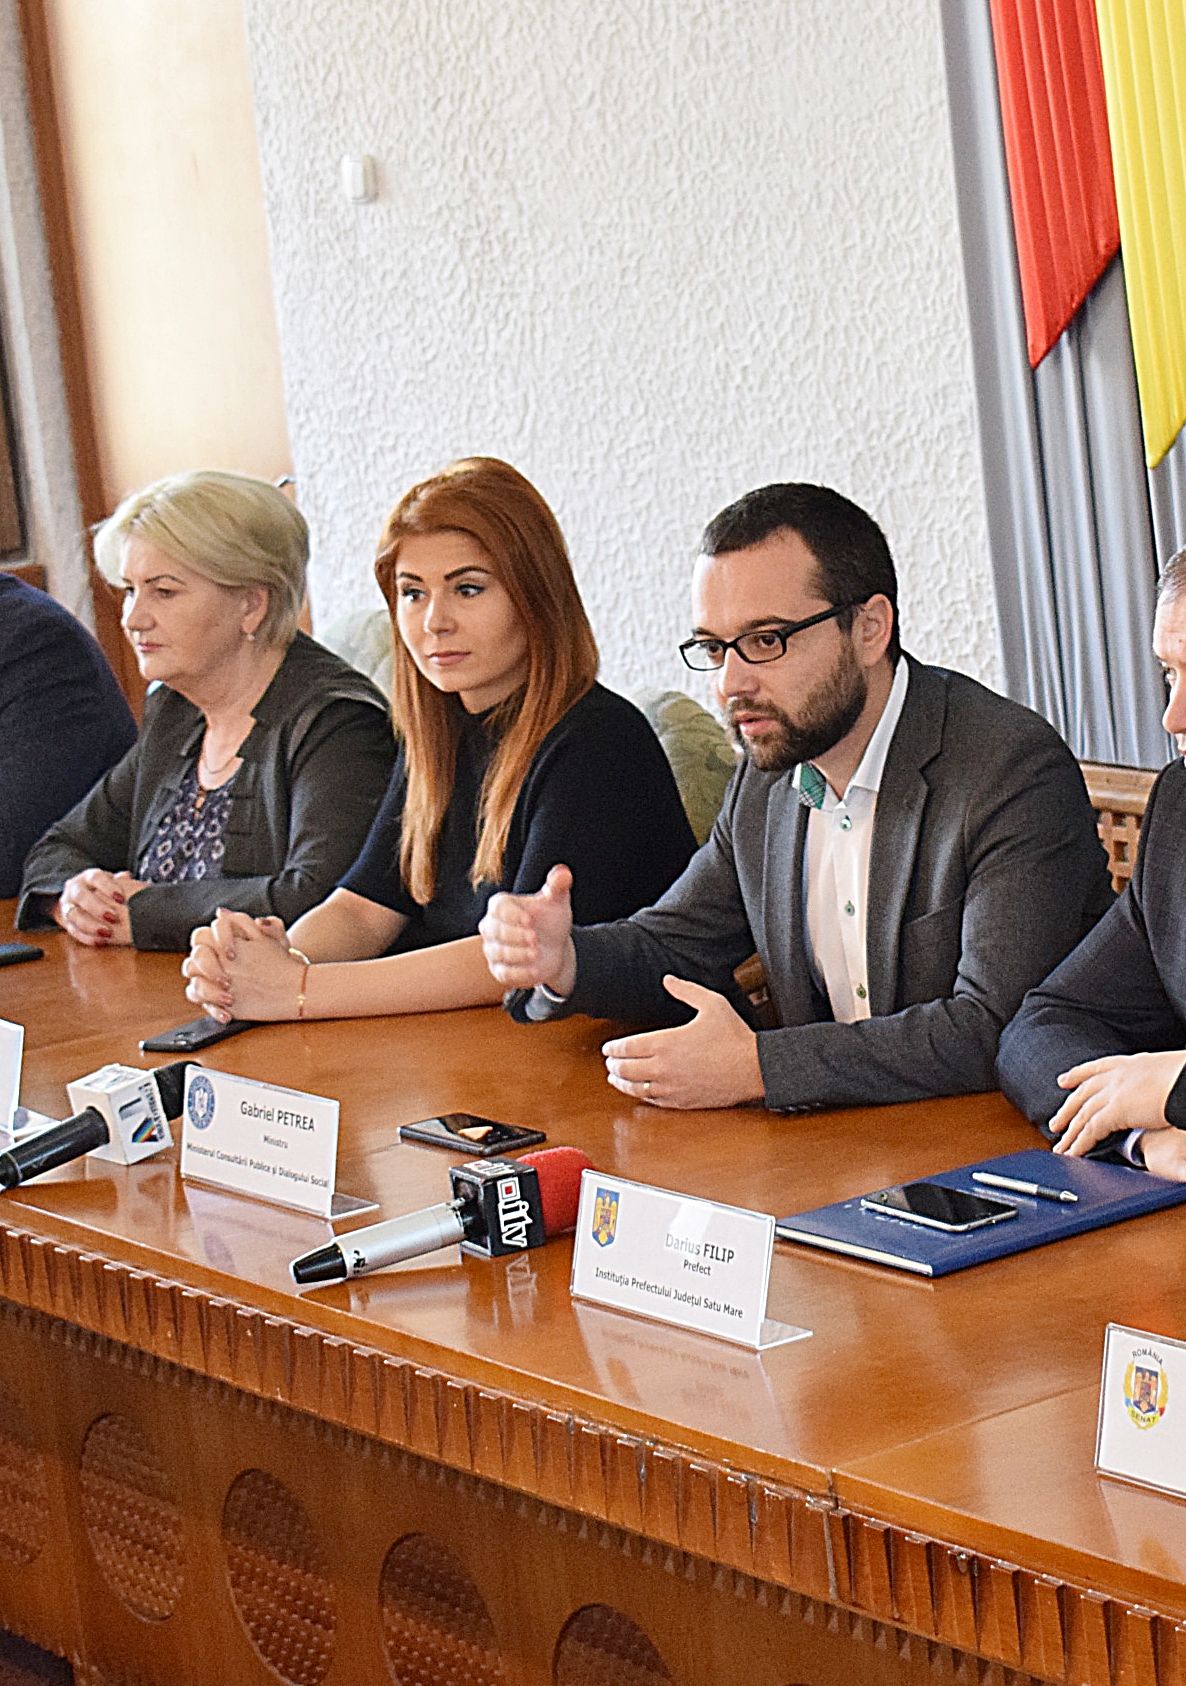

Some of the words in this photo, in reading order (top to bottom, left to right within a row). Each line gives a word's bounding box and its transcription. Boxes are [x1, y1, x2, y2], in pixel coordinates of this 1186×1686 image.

[240, 1101, 274, 1122] Gabriel
[277, 1110, 315, 1132] PETREA
[311, 1175, 330, 1188] Social
[665, 1233, 700, 1255] Darius
[703, 1243, 735, 1263] FILIP
[683, 1259, 711, 1276] Prefect
[631, 1277, 672, 1297] Prefectului
[704, 1298, 722, 1313] Satu
[723, 1304, 743, 1318] Mare
[1131, 1409, 1156, 1423] SENAT
